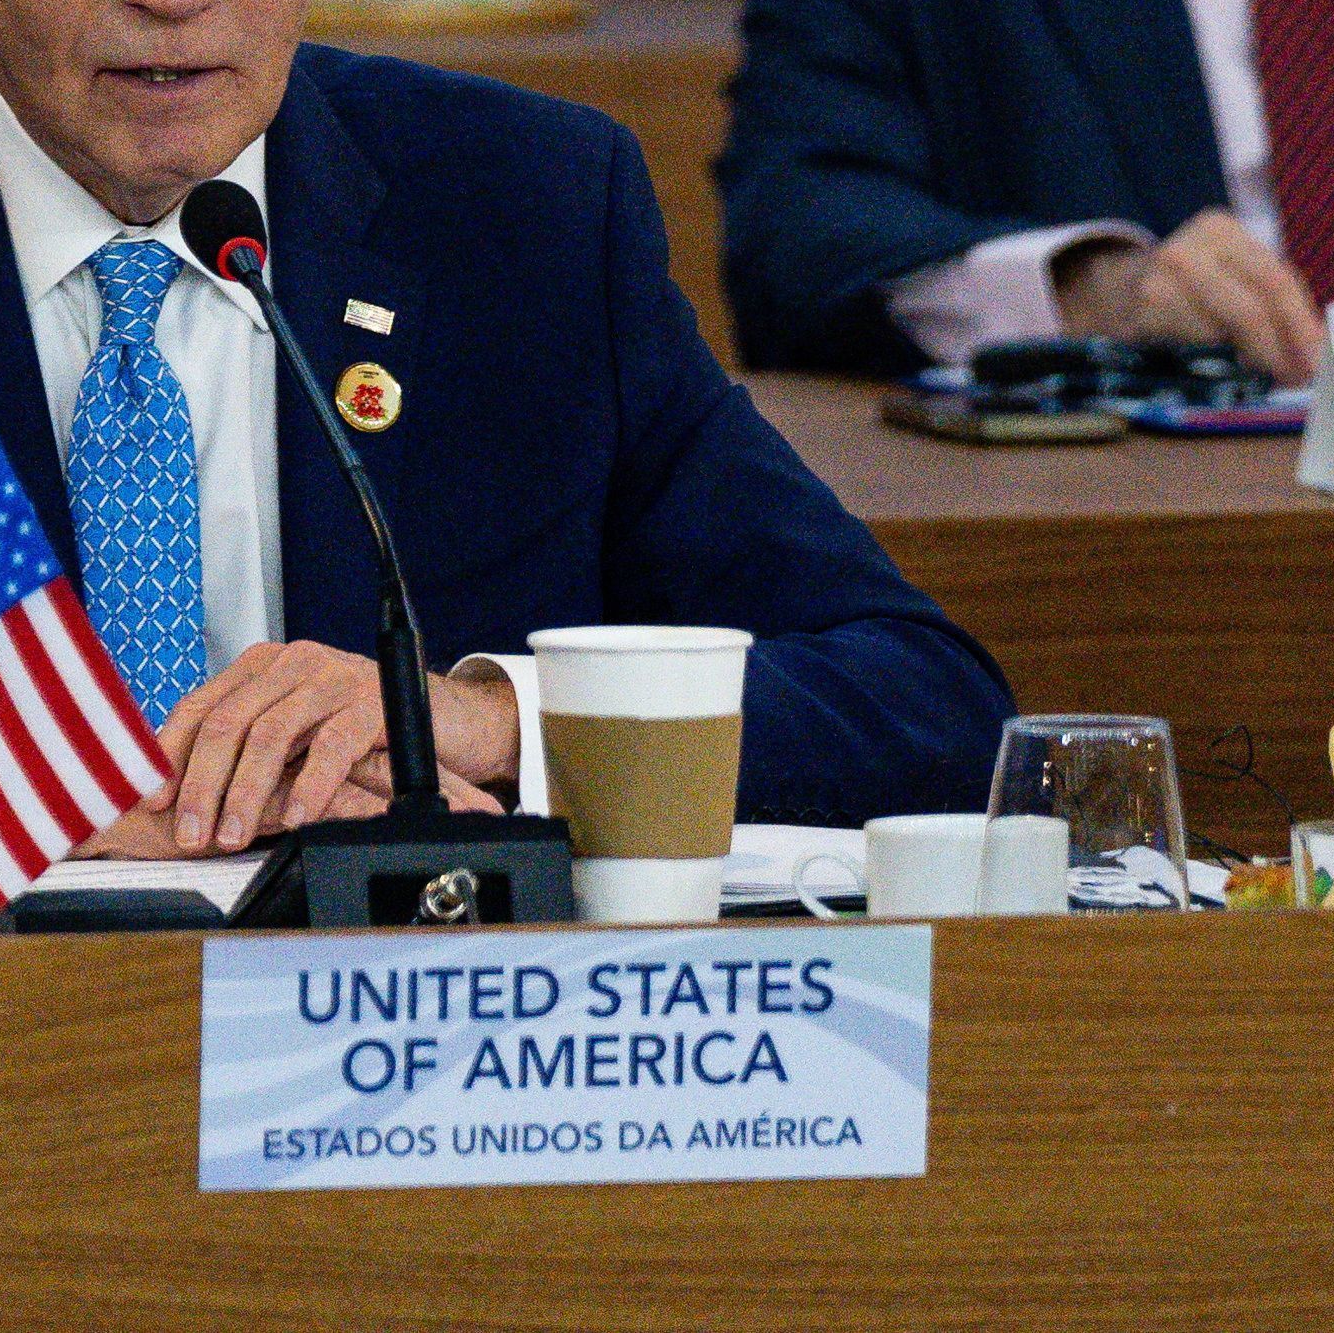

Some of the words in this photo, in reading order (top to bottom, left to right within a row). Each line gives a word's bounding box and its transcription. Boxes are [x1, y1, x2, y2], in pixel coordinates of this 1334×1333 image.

[297, 965, 560, 1024] UNITED
[586, 958, 835, 1018] STATES
[341, 1037, 438, 1094] OF
[463, 1030, 788, 1090] AMERICA
[263, 1126, 437, 1160] ESTADOS
[452, 1121, 603, 1155] UNIDOS
[618, 1120, 672, 1151] DA
[687, 1111, 863, 1149] AMÉRICA
